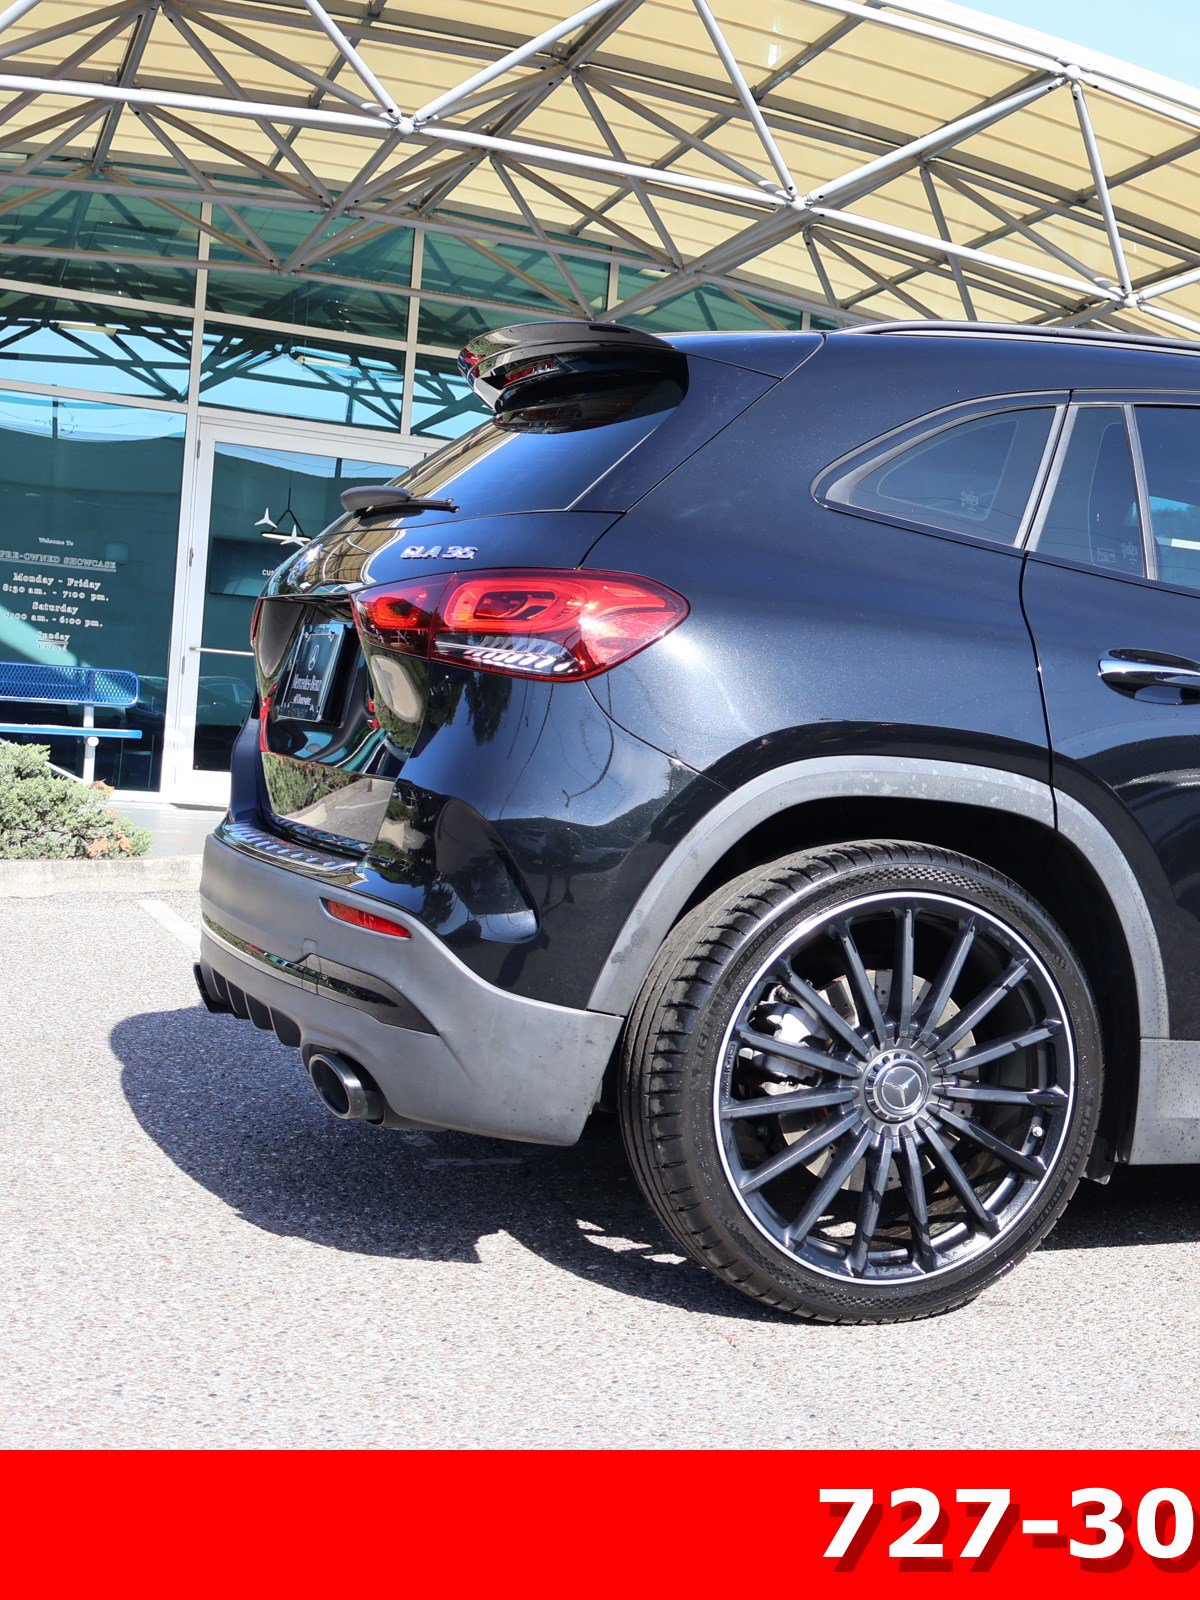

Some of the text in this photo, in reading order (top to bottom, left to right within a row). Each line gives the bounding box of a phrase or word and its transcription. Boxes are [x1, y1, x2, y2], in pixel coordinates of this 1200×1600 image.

[38, 536, 74, 547] Welcome To
[63, 556, 117, 569] SHOWCASE
[13, 572, 54, 586] Monday
[67, 577, 102, 591] Friday
[2, 583, 26, 594] 8:30
[28, 587, 47, 596] am.
[62, 590, 86, 599] 7:00
[90, 593, 109, 602] pm.
[32, 601, 79, 615] Saturday
[31, 614, 49, 622] am.
[59, 615, 82, 625] 6:00
[84, 619, 103, 628] pm.
